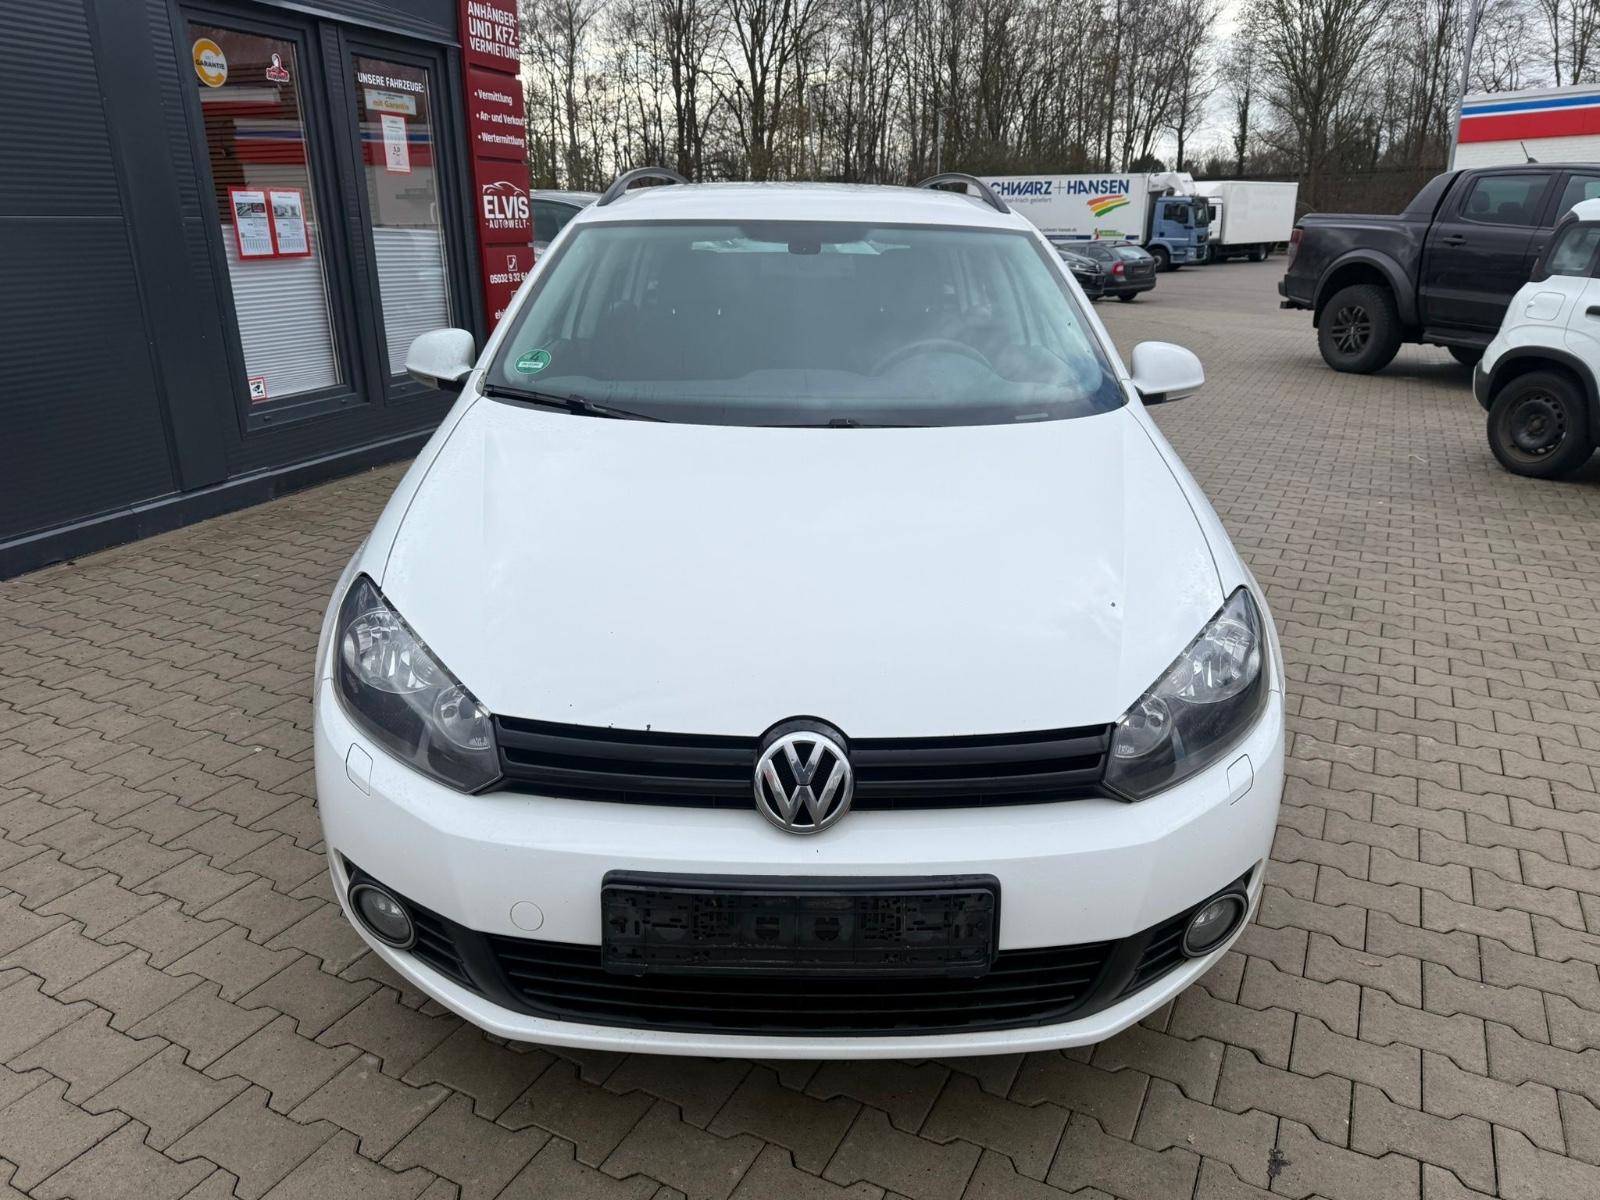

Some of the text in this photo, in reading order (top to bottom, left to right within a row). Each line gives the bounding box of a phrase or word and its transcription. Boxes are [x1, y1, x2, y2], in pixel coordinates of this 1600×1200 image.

[467, 1, 517, 27] ANHÄNGER-
[468, 17, 518, 46] UND KFZ-
[469, 36, 520, 60] VERMIETUNG
[357, 72, 385, 88] UNSERE
[478, 89, 513, 106] Vermittlung
[491, 113, 503, 123] und
[481, 132, 525, 148] Wertermittlung
[990, 180, 1053, 196] CHWARZ
[1067, 179, 1130, 195] HANSEN
[483, 195, 530, 219] ELVIS
